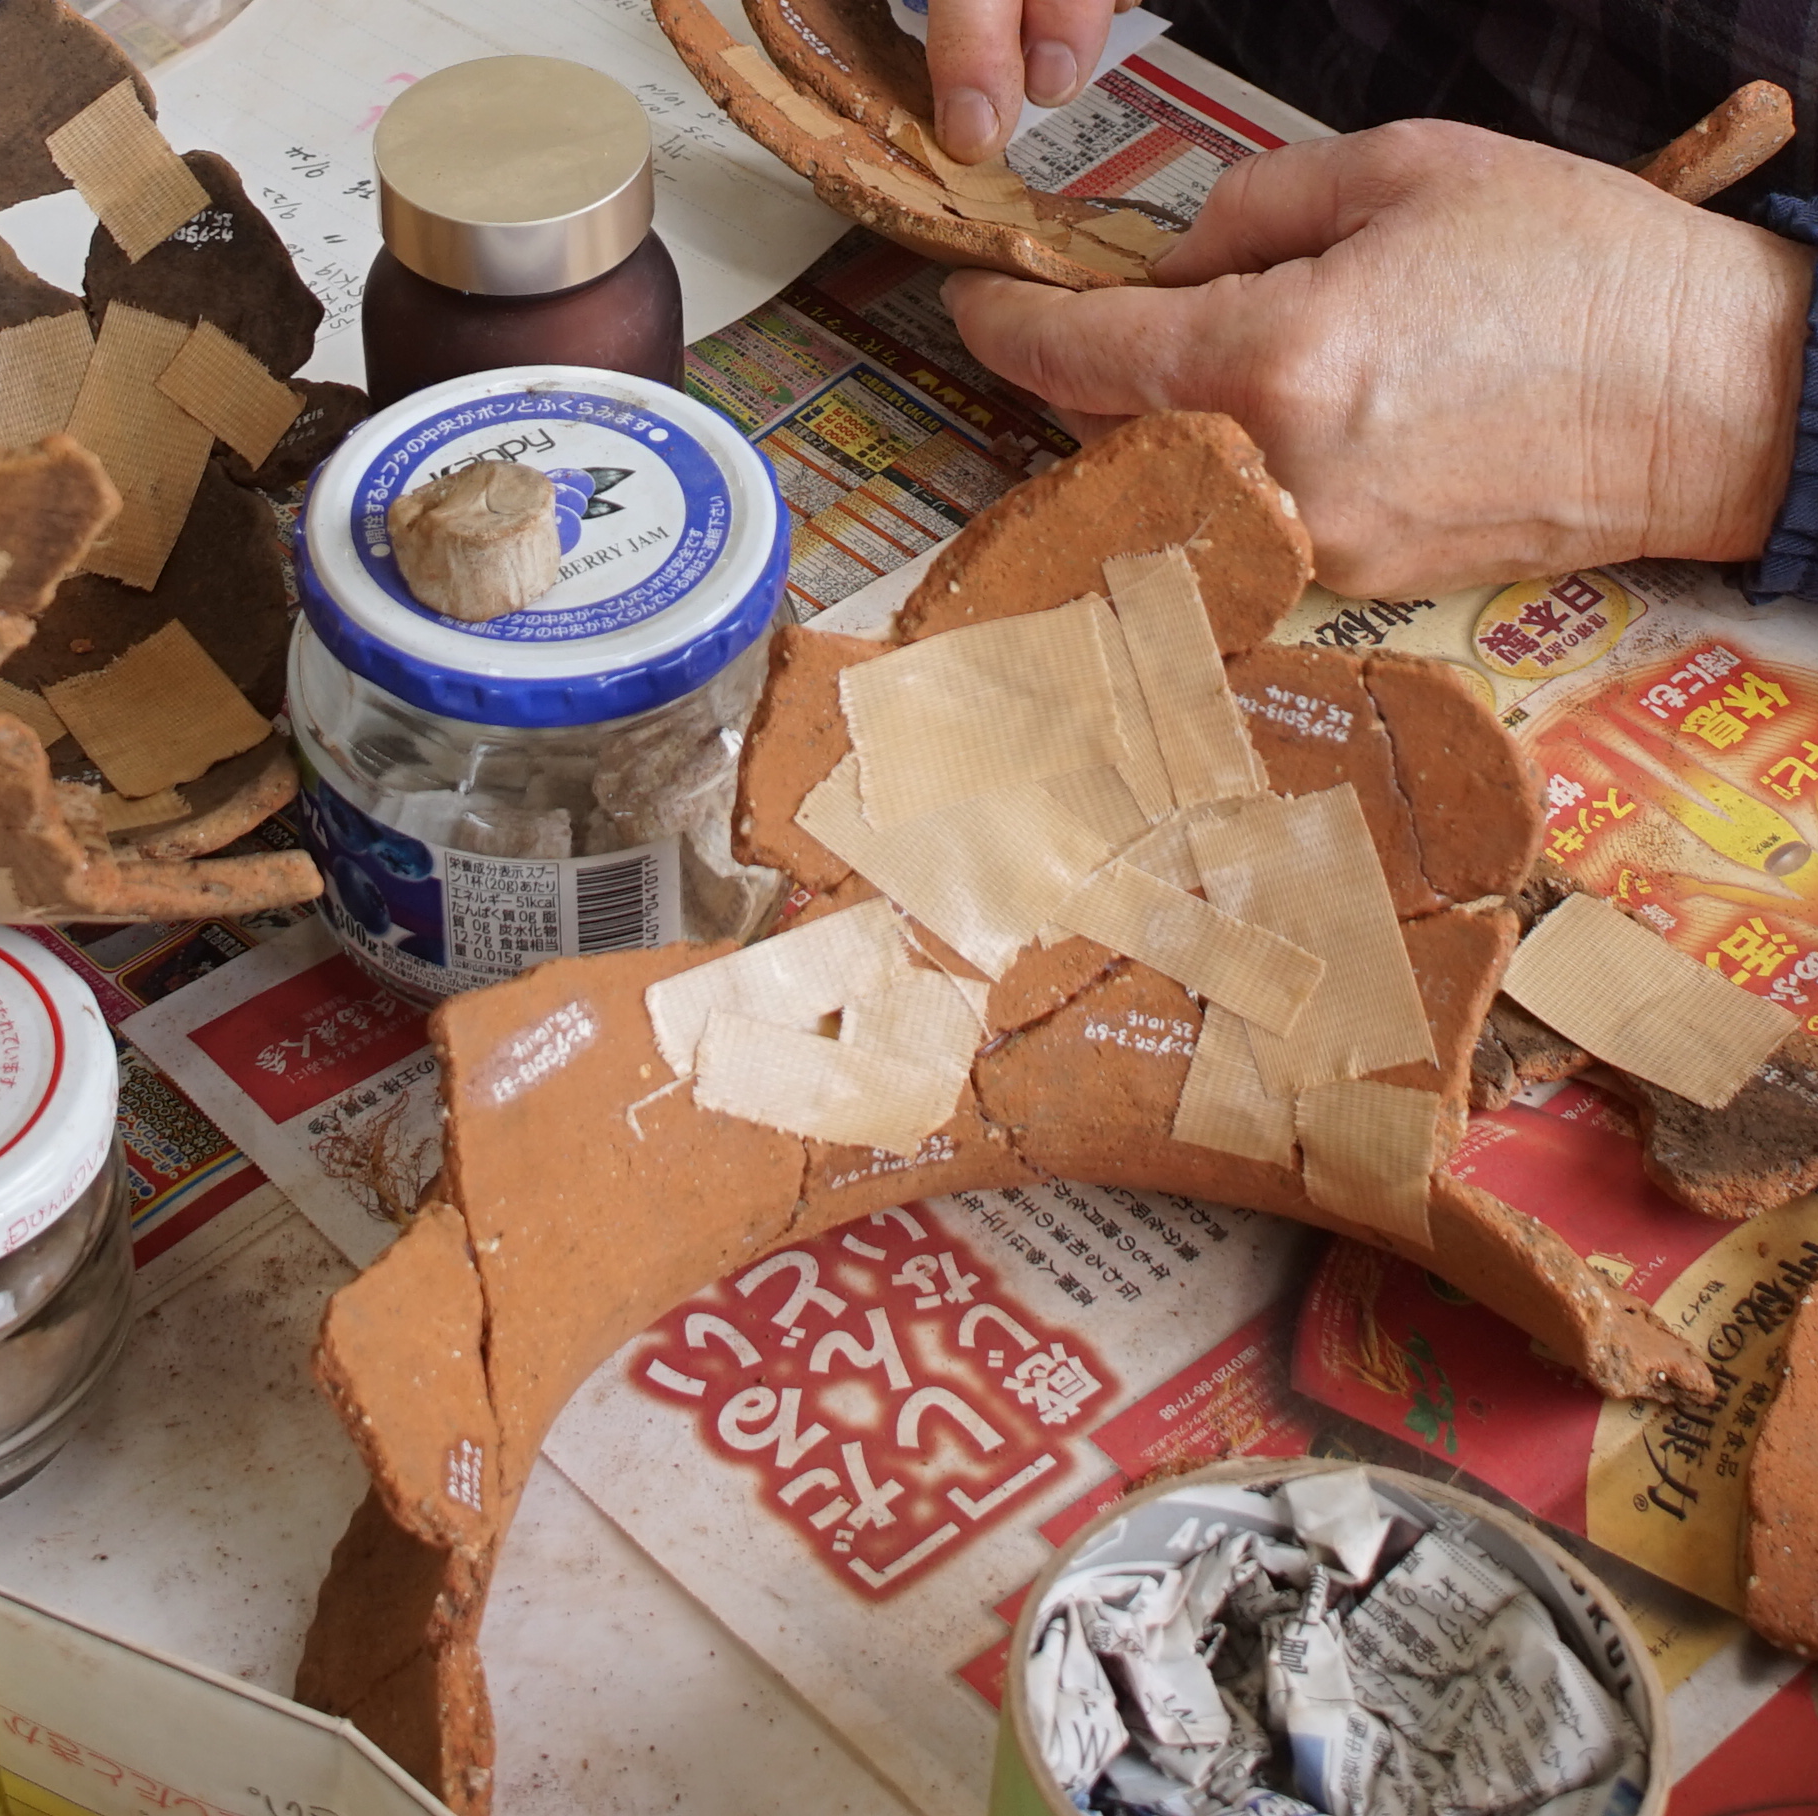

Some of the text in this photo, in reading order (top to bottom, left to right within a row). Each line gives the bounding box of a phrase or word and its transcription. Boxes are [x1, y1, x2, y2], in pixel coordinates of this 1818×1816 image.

[630, 526, 672, 555] JAM
[1477, 574, 1606, 668] 日本製
[1644, 643, 1743, 720] 時にも!
[1679, 671, 1794, 751] 休息
[451, 888, 557, 909] エネルギー 51kcal
[451, 900, 517, 922] たんぱく質
[518, 909, 538, 925] 0g
[452, 929, 559, 952] 12.7g 食塩相当
[498, 924, 558, 939] 炭水化物
[472, 947, 523, 966] 0.015g
